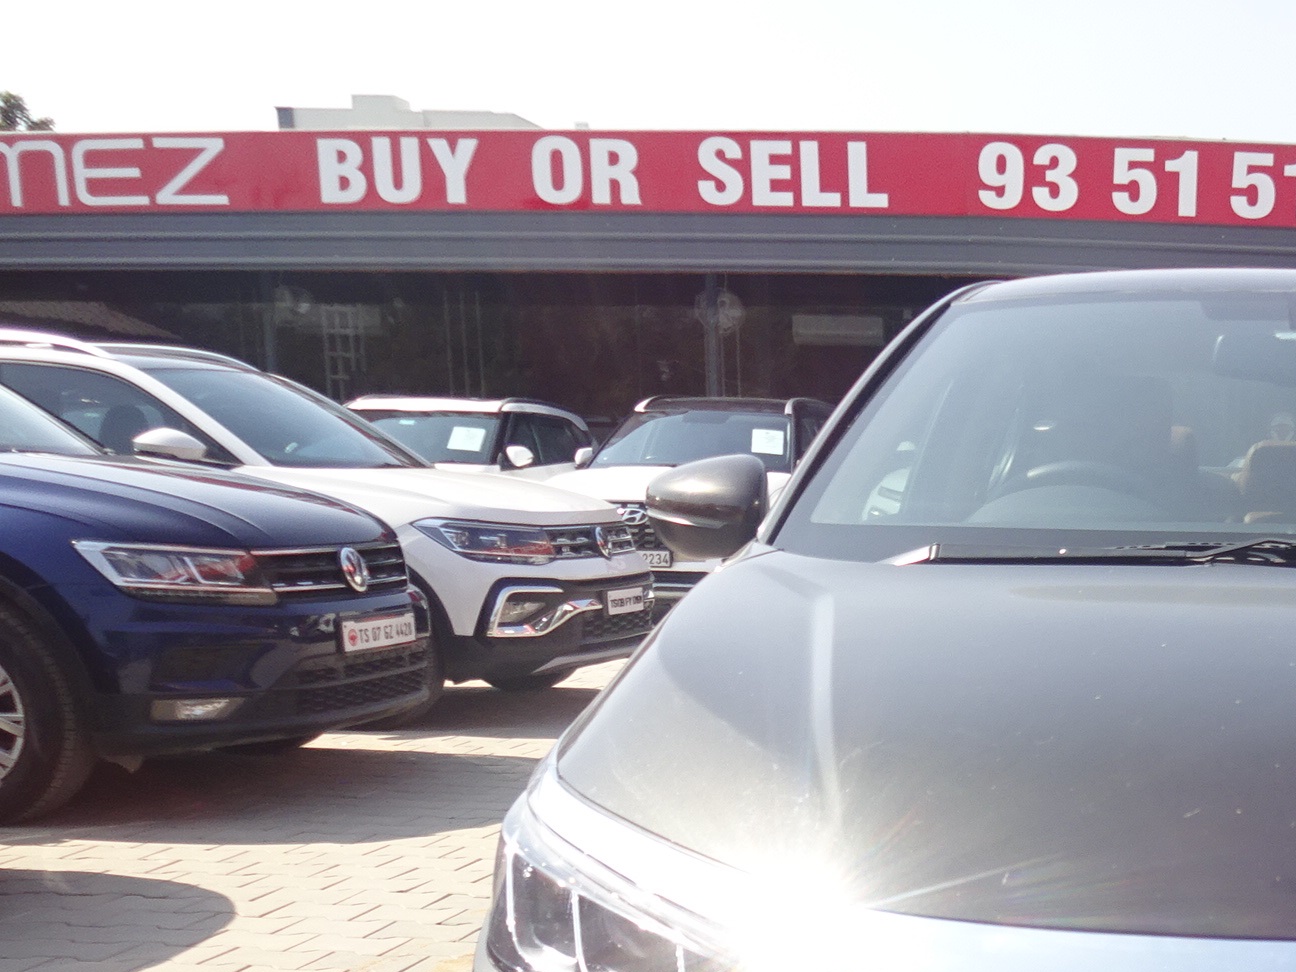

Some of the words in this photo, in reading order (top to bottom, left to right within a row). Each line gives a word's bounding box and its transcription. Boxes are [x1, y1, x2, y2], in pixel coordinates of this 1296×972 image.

[316, 137, 479, 205] BUY
[531, 136, 642, 206] OR
[697, 136, 889, 208] SELL
[977, 141, 1079, 212] 93
[1111, 147, 1199, 217] 51
[358, 628, 370, 644] TS
